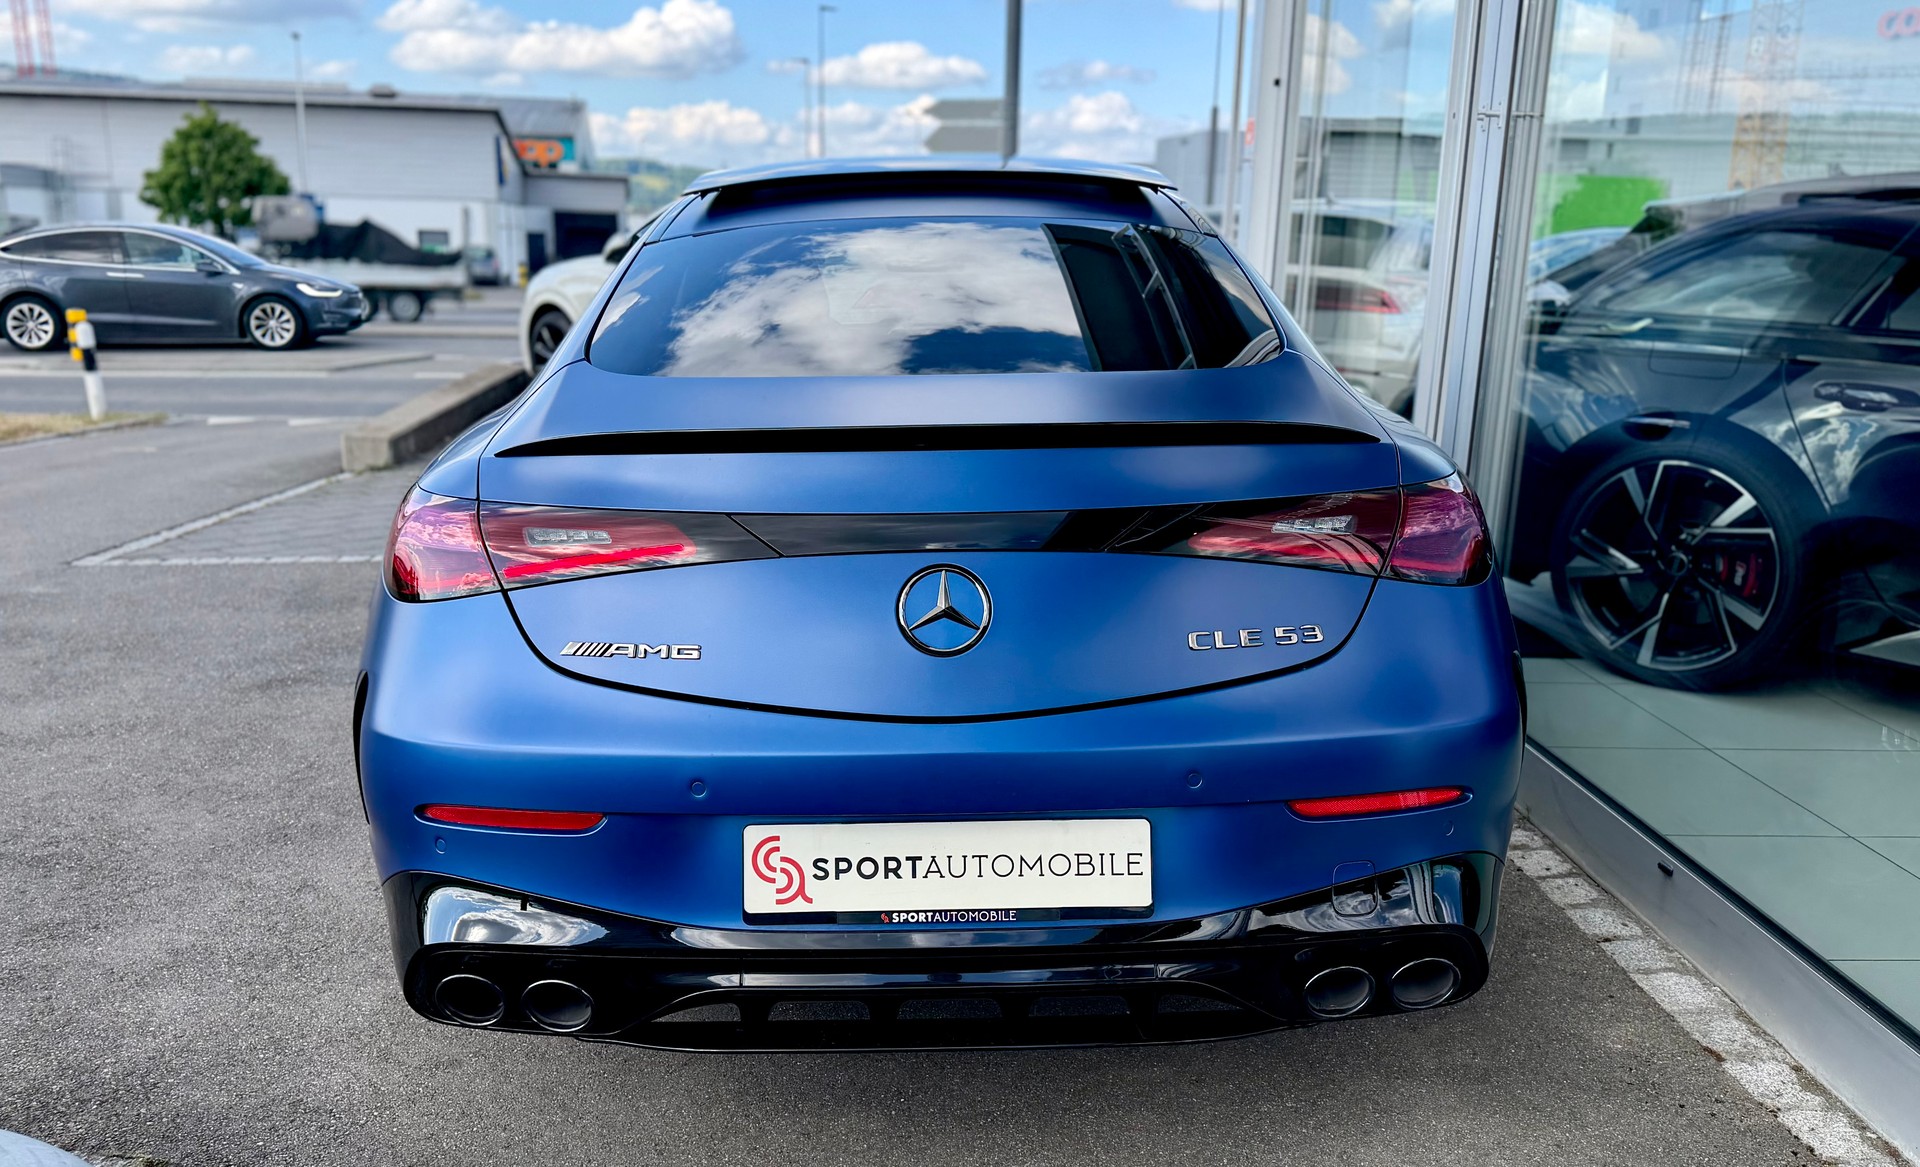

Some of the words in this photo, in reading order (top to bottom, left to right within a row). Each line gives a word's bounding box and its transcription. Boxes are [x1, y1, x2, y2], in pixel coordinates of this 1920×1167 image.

[1187, 628, 1264, 651] CLE
[1273, 624, 1324, 646] 53
[604, 642, 702, 660] AMG
[812, 852, 1144, 881] SPORTAUTOMOBILE
[891, 910, 1017, 923] SPORTAUTOMOBILE
